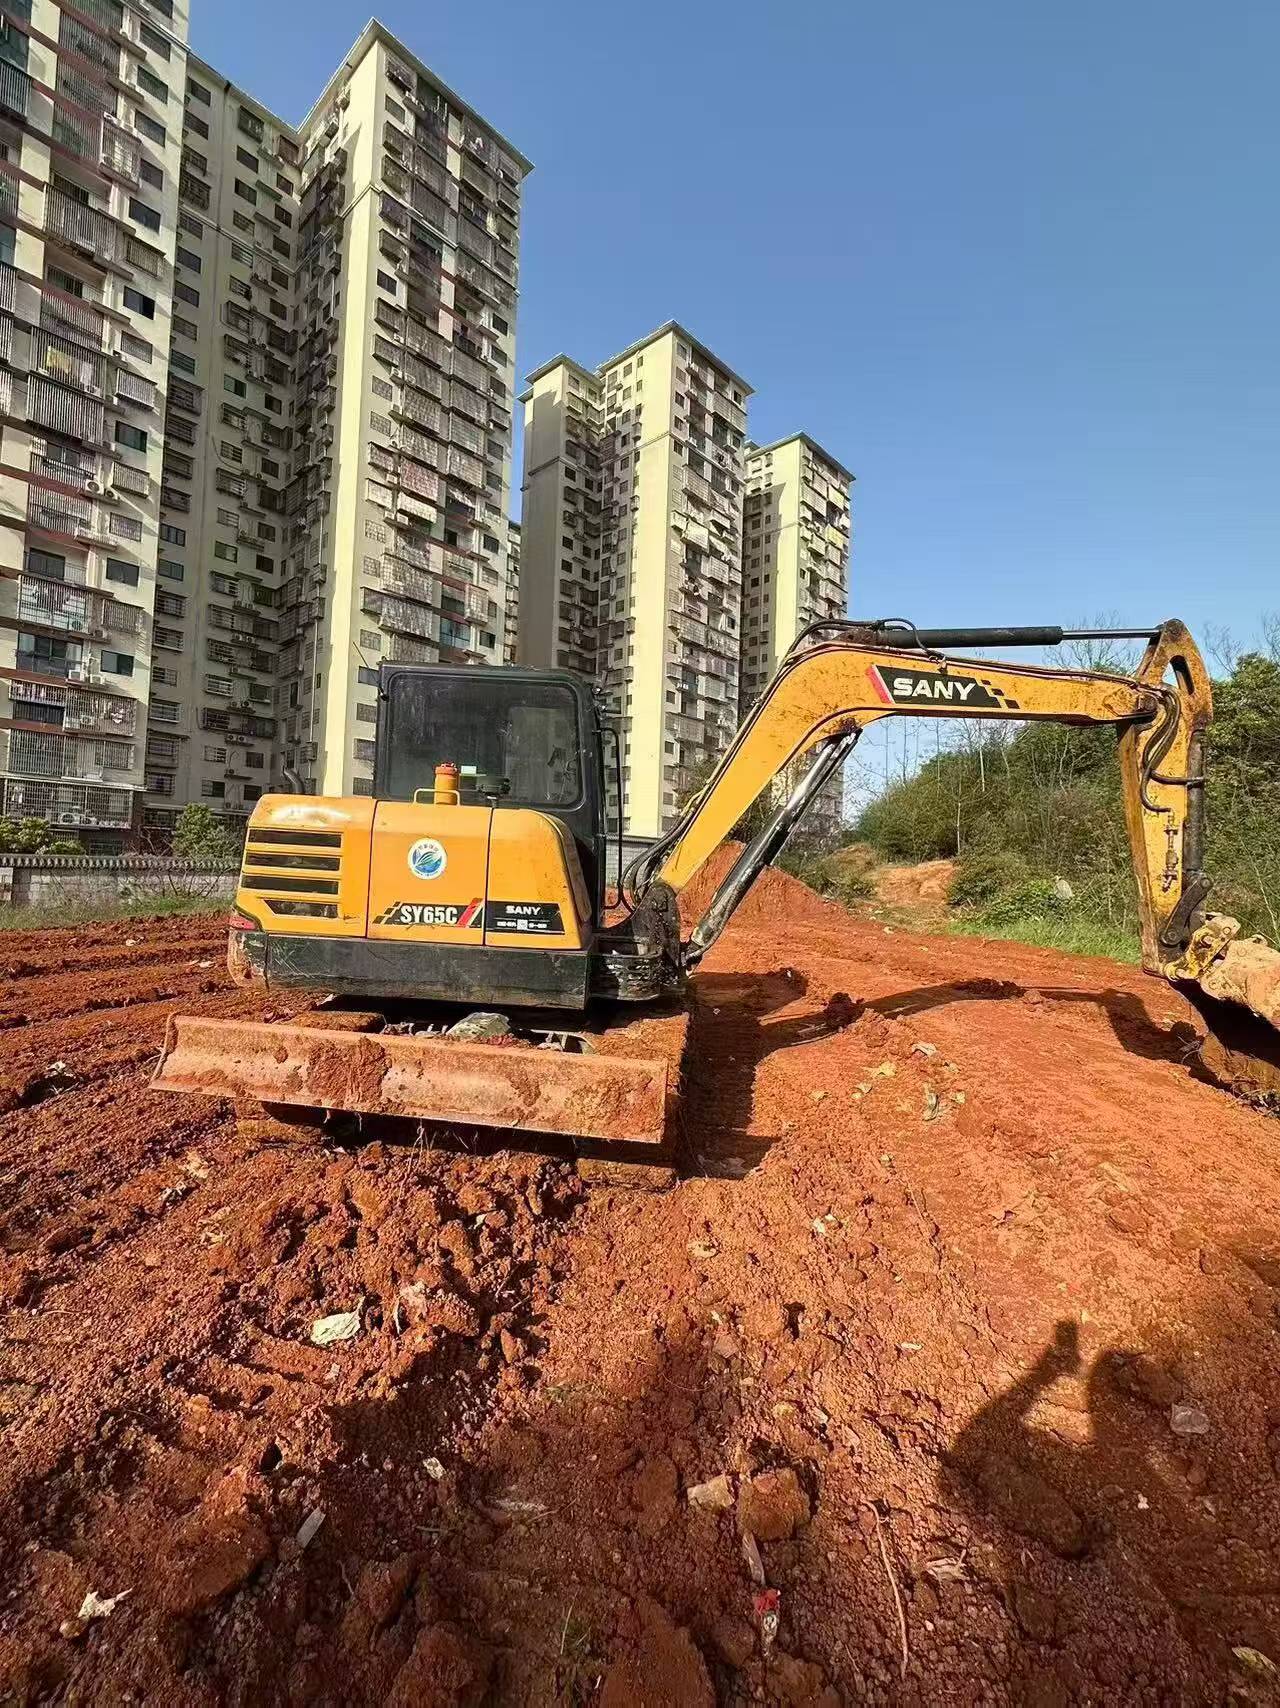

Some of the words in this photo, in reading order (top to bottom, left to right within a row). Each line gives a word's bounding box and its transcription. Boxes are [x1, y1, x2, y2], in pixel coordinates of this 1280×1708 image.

[893, 678, 976, 700] SANY
[399, 905, 458, 925] SY65C
[506, 905, 541, 915] SANY
